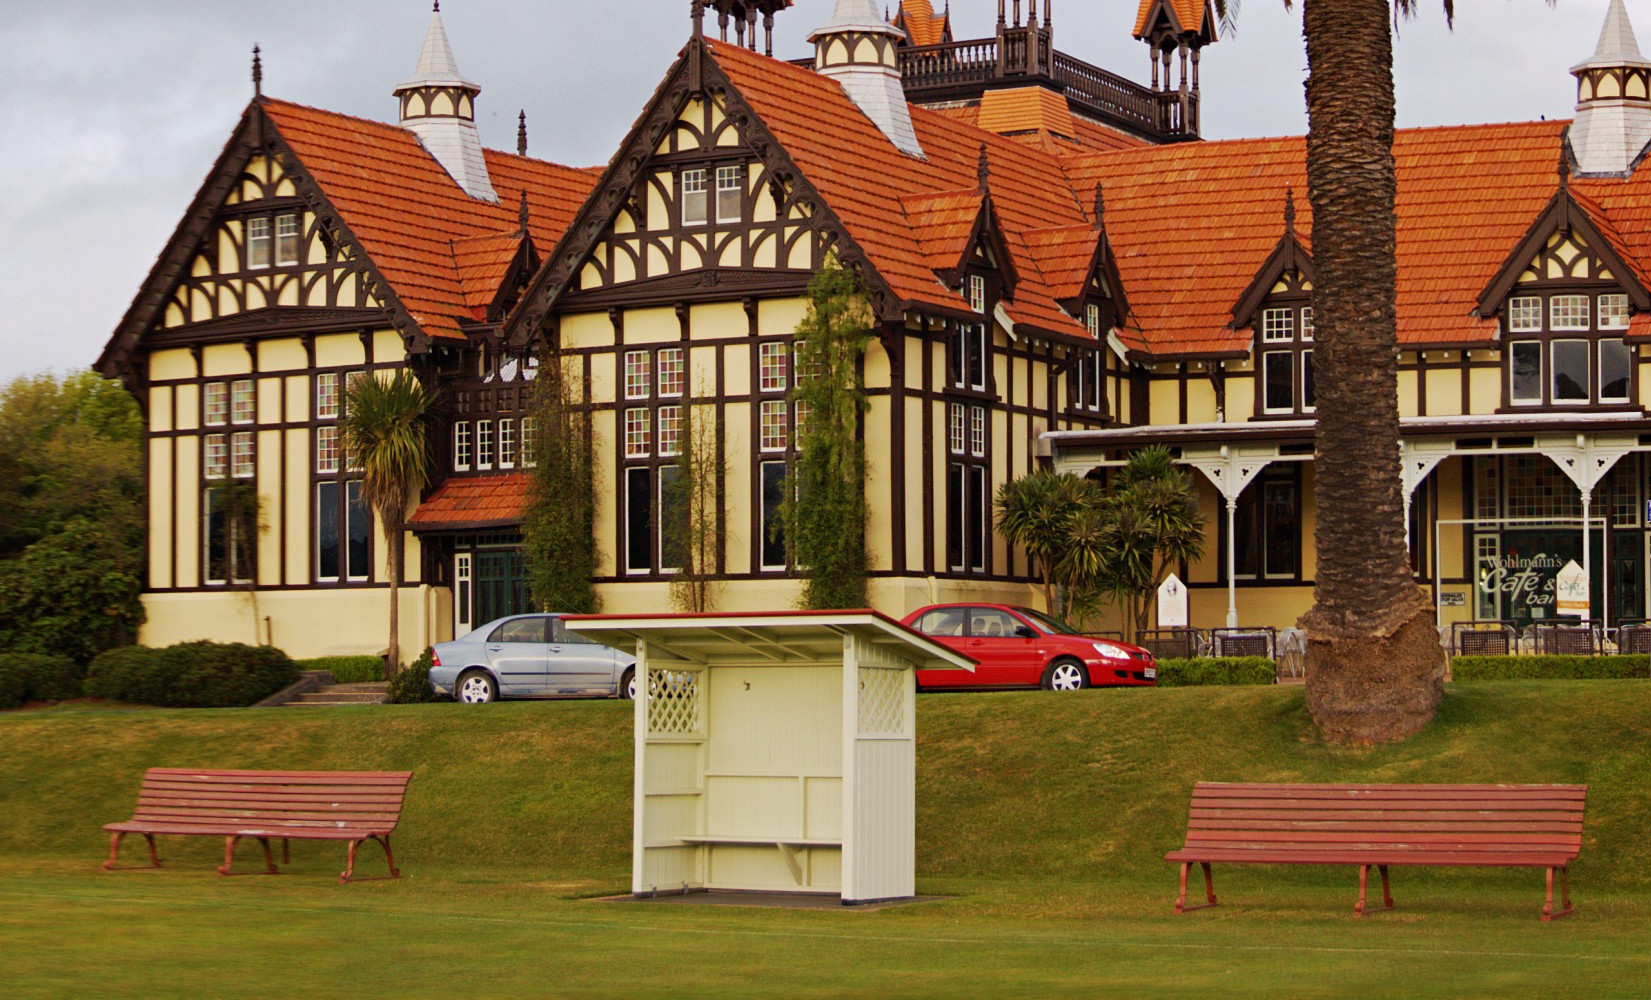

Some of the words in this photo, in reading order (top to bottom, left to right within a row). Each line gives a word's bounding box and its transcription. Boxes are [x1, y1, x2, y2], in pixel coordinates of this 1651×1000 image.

[1487, 553, 1562, 569] Wohlmann's
[1482, 552, 1544, 603] Café
[1543, 578, 1555, 591] &
[1526, 591, 1555, 606] bar
